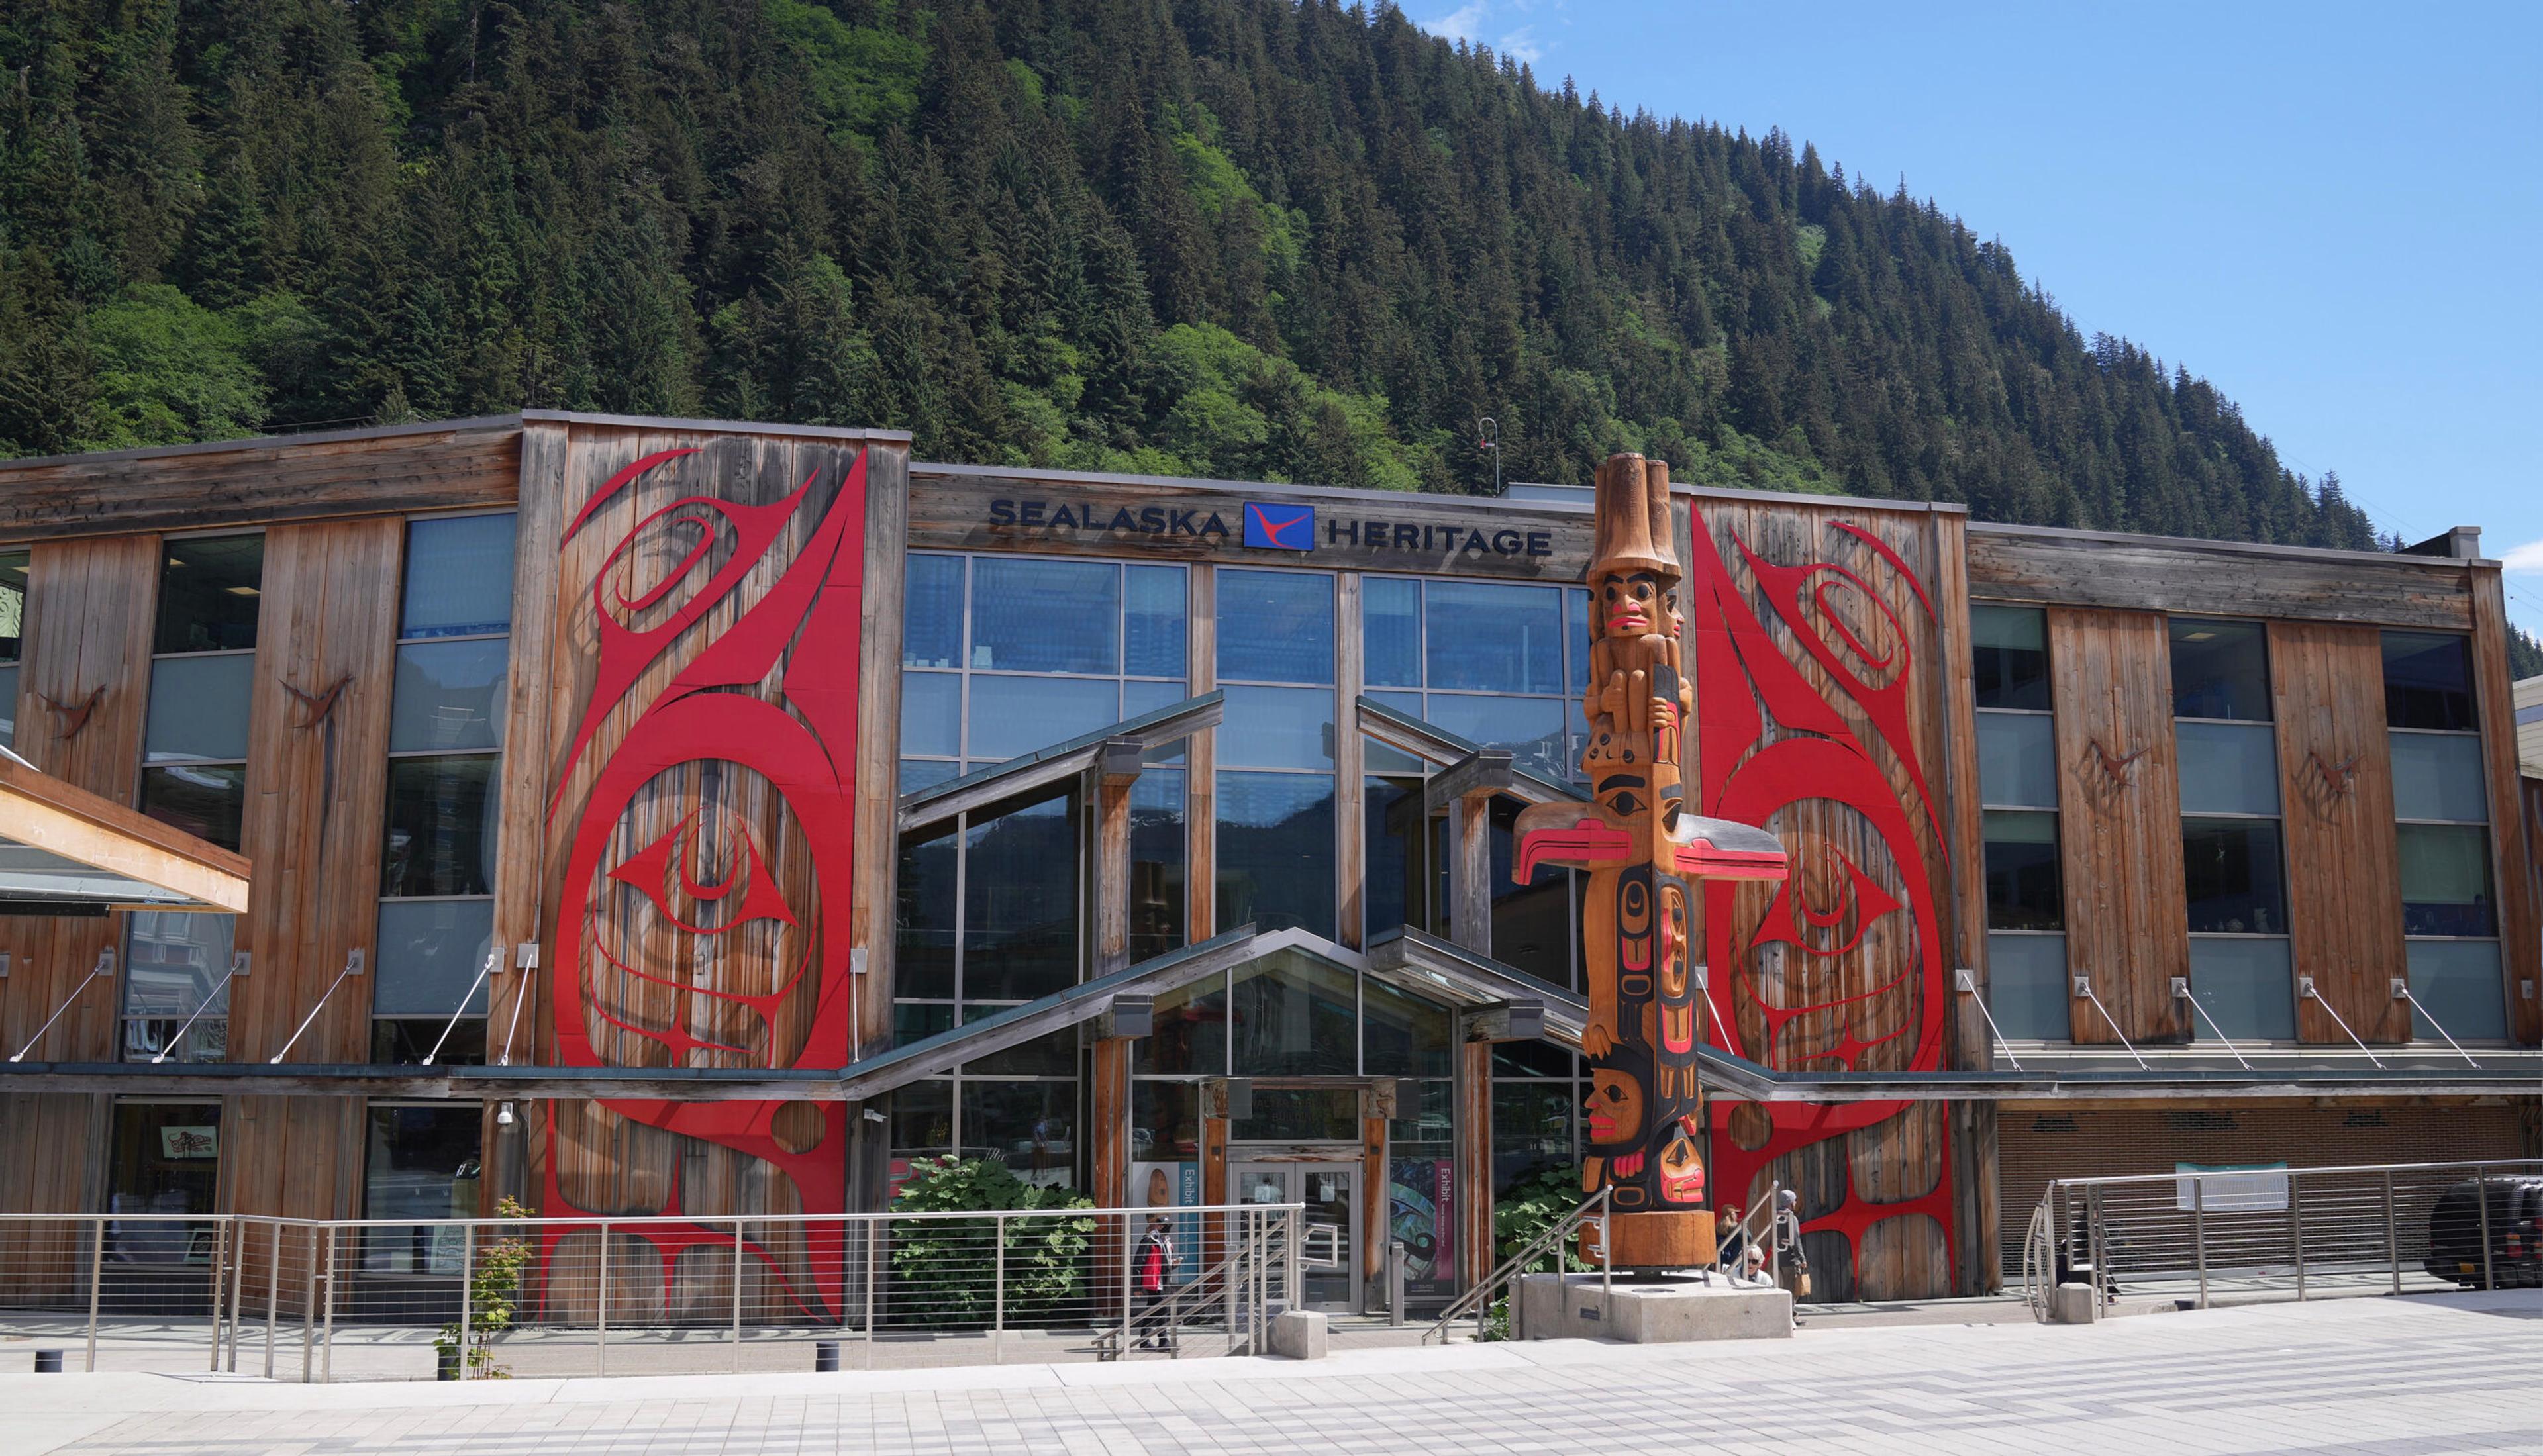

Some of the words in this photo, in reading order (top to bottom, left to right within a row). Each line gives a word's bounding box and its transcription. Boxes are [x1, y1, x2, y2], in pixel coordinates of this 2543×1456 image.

[989, 499, 1230, 538] SEALASKA
[1328, 519, 1552, 556] HERITAGE
[1185, 1169, 1195, 1204] Exhibit
[1441, 1167, 1450, 1202] Exhibit
